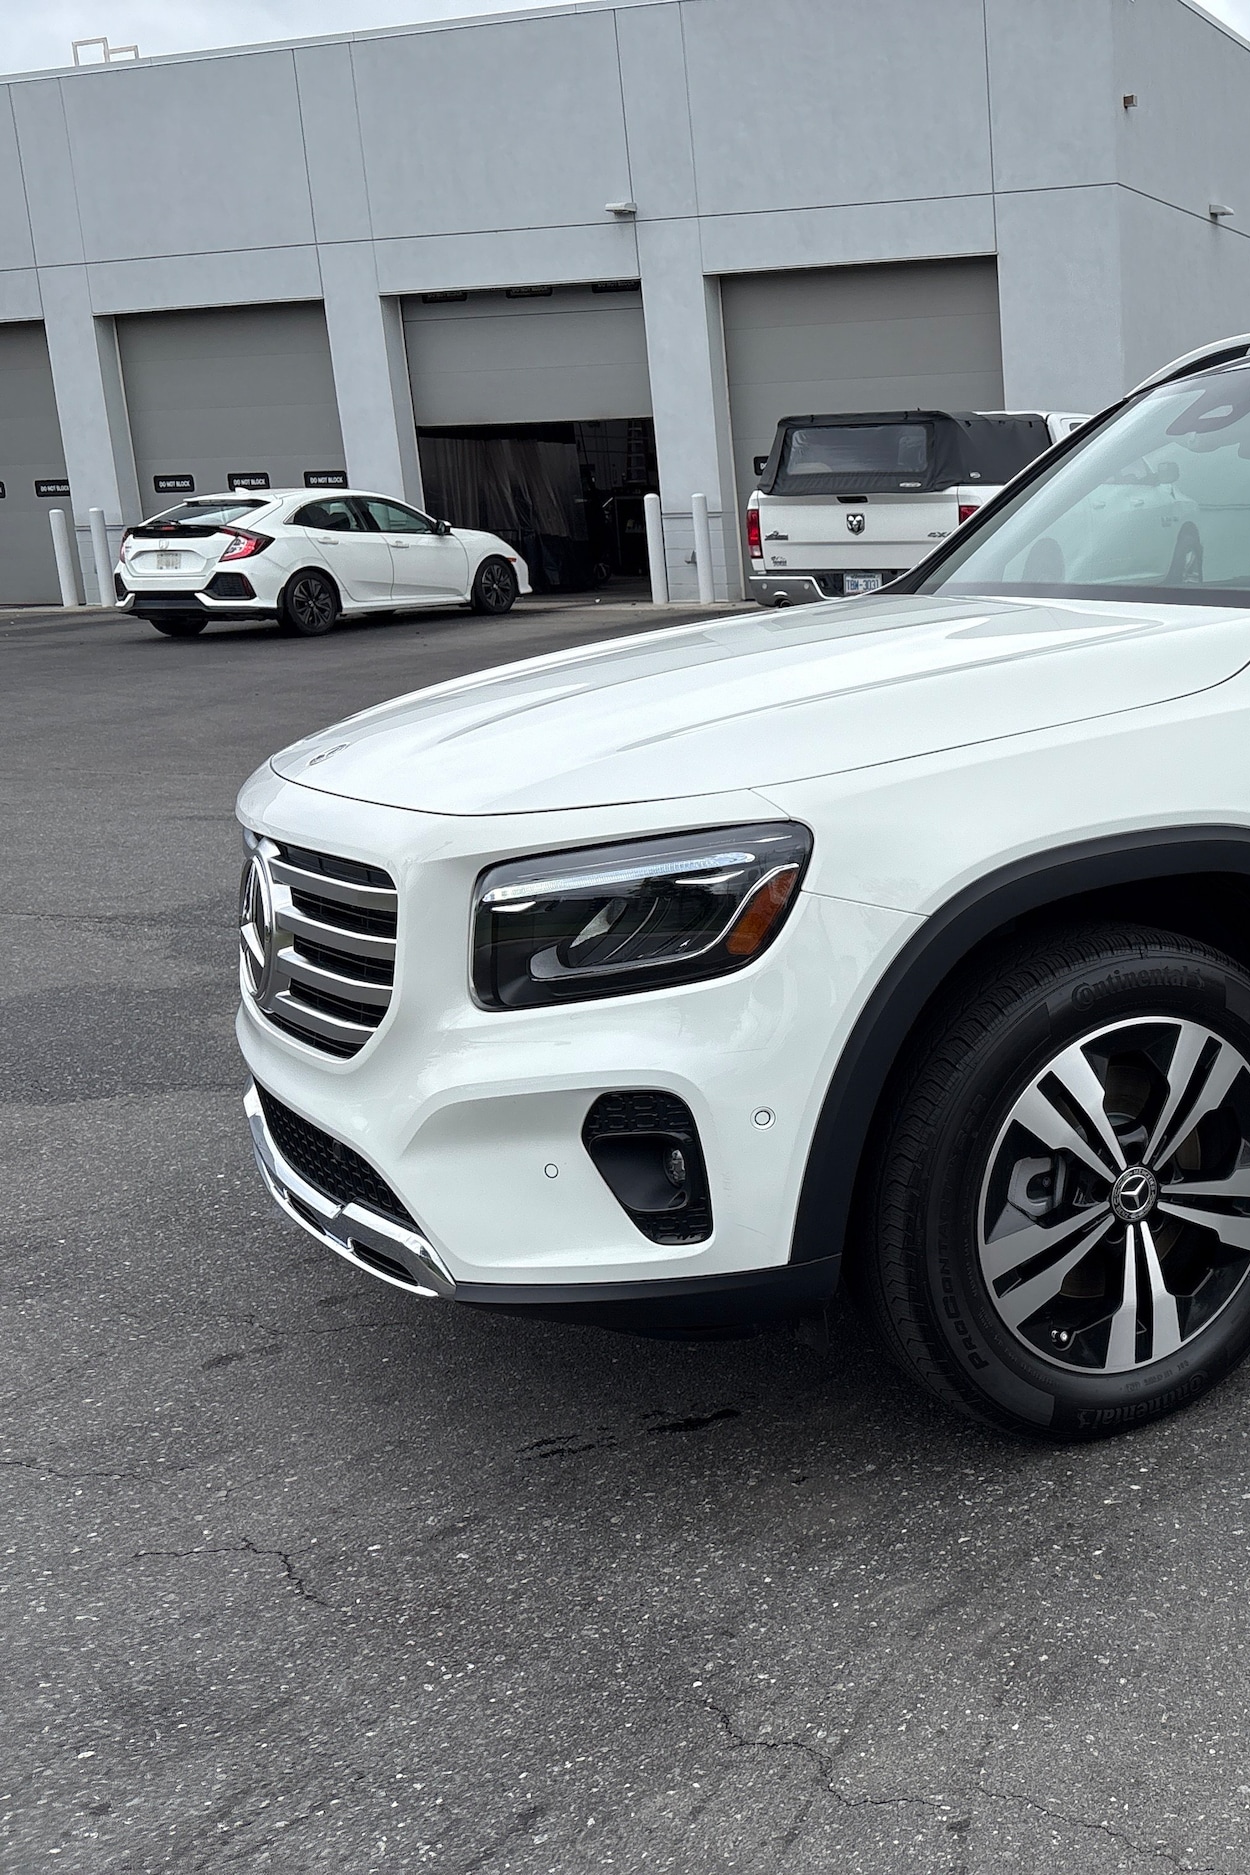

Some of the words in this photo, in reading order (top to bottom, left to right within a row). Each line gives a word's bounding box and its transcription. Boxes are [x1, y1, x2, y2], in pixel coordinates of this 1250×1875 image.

[159, 480, 166, 488] DO
[233, 478, 240, 486] DO
[241, 478, 250, 486] NOT
[310, 476, 318, 484] DO
[1071, 965, 1189, 1012] Continental
